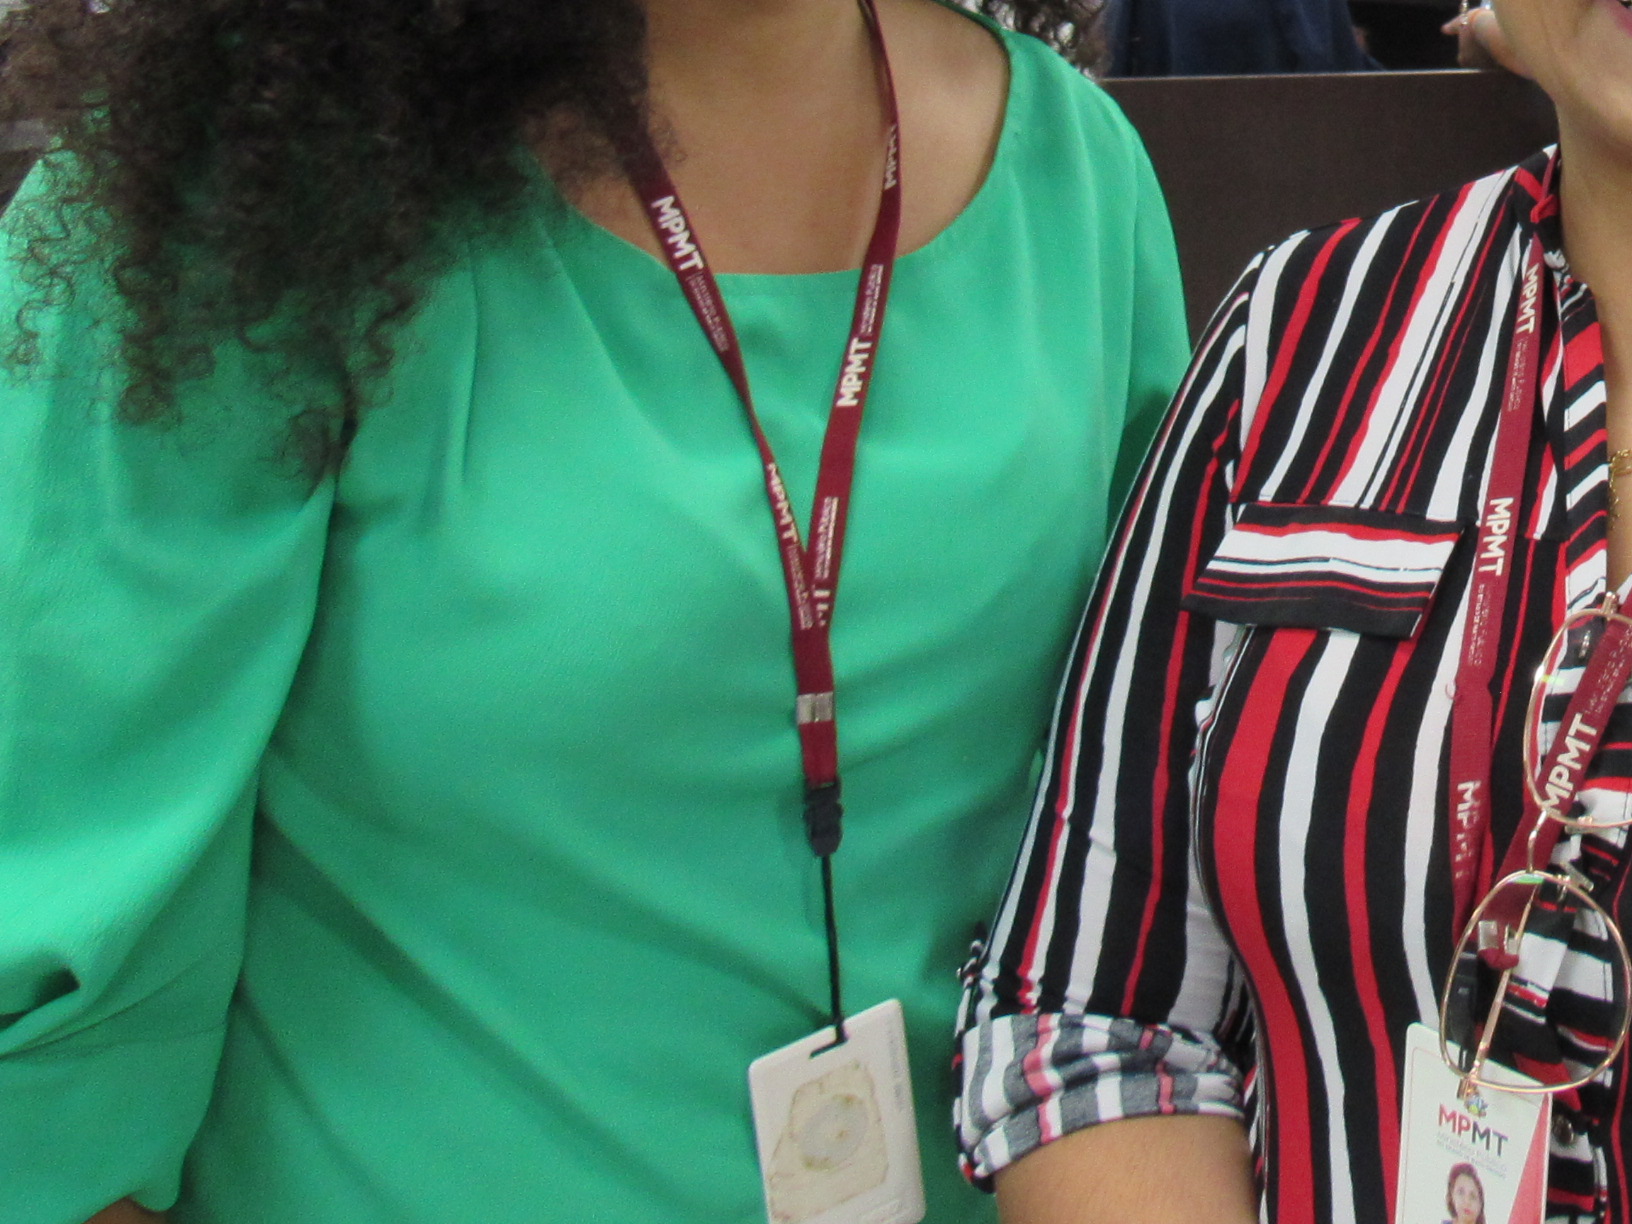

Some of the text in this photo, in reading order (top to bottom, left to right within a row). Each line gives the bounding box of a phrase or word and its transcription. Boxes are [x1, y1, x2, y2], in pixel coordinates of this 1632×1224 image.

[651, 195, 704, 271] MPMT
[1516, 263, 1539, 334] MPMT
[837, 337, 872, 408] MPMT
[767, 462, 798, 542] MPMT
[1478, 497, 1514, 576] MPMT
[1542, 713, 1597, 816] MPMT
[1439, 1103, 1508, 1157] MPMT
